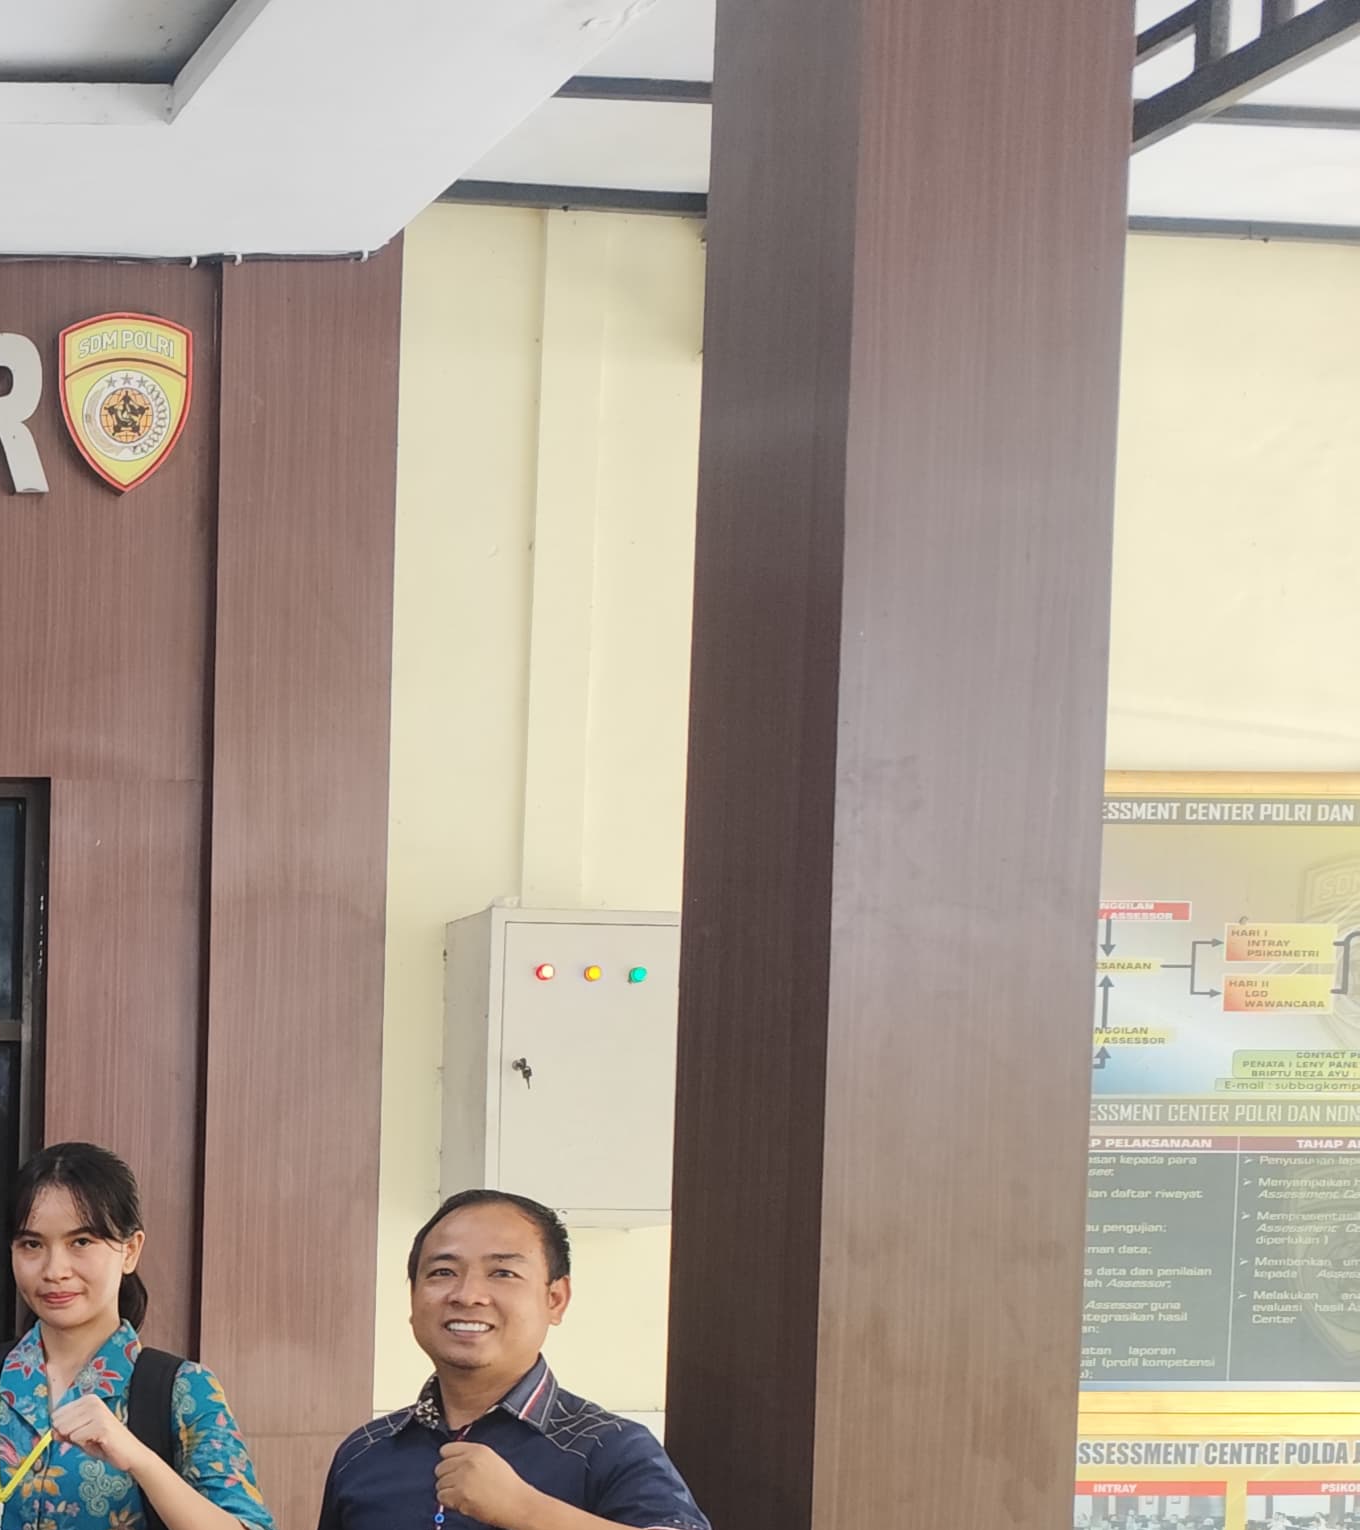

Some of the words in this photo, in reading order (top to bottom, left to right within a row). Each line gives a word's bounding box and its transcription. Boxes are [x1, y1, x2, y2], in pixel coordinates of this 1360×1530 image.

[79, 330, 117, 358] SDM
[122, 330, 175, 359] POLRI
[1102, 801, 1180, 820] SSMENT
[1185, 803, 1254, 821] CENTER
[1259, 803, 1311, 821] POLRI
[1317, 804, 1355, 822] DAN
[1110, 912, 1173, 920] ASSESSOR
[1231, 929, 1260, 937] HARI
[1247, 950, 1319, 958] PSIKOMETRI
[1229, 980, 1258, 988] HARI
[1245, 990, 1268, 998] LGD
[1244, 1000, 1325, 1008] WAWANCARA
[1095, 1026, 1149, 1035] NGGILAN
[1296, 1051, 1346, 1059] CONTACT
[1242, 1060, 1285, 1068] PENATA
[1296, 1060, 1324, 1069] LENY
[1328, 1061, 1360, 1069] PANE
[1275, 1080, 1360, 1092] subbagkomp
[1089, 1103, 1163, 1122] ESSMENT
[1168, 1104, 1229, 1122] CENTER
[1235, 1104, 1281, 1122] POLRI
[1287, 1105, 1320, 1122] DAN
[1105, 1138, 1212, 1149] PELAKSANAAN
[1296, 1139, 1343, 1149] TAHAP
[1120, 1155, 1164, 1166] kepada
[1167, 1155, 1197, 1166] para
[1111, 1188, 1152, 1199] daftar
[1155, 1188, 1203, 1200] riwayat
[1096, 1266, 1126, 1276] data
[1130, 1266, 1153, 1276] dan
[1157, 1266, 1213, 1277] penilaian
[1085, 1300, 1149, 1310] Assessor
[1151, 1302, 1181, 1312] guna
[1082, 1312, 1154, 1323] tegrasikan
[1158, 1312, 1188, 1322] hasil
[1252, 1314, 1296, 1324] Center
[1128, 1345, 1176, 1357] laporan
[1142, 1357, 1216, 1369] kompetensi
[1078, 1442, 1198, 1465] SSESSMENT
[1203, 1443, 1279, 1465] CENTRE
[1285, 1443, 1349, 1465] POLDA
[1093, 1484, 1137, 1493] INTRAY
